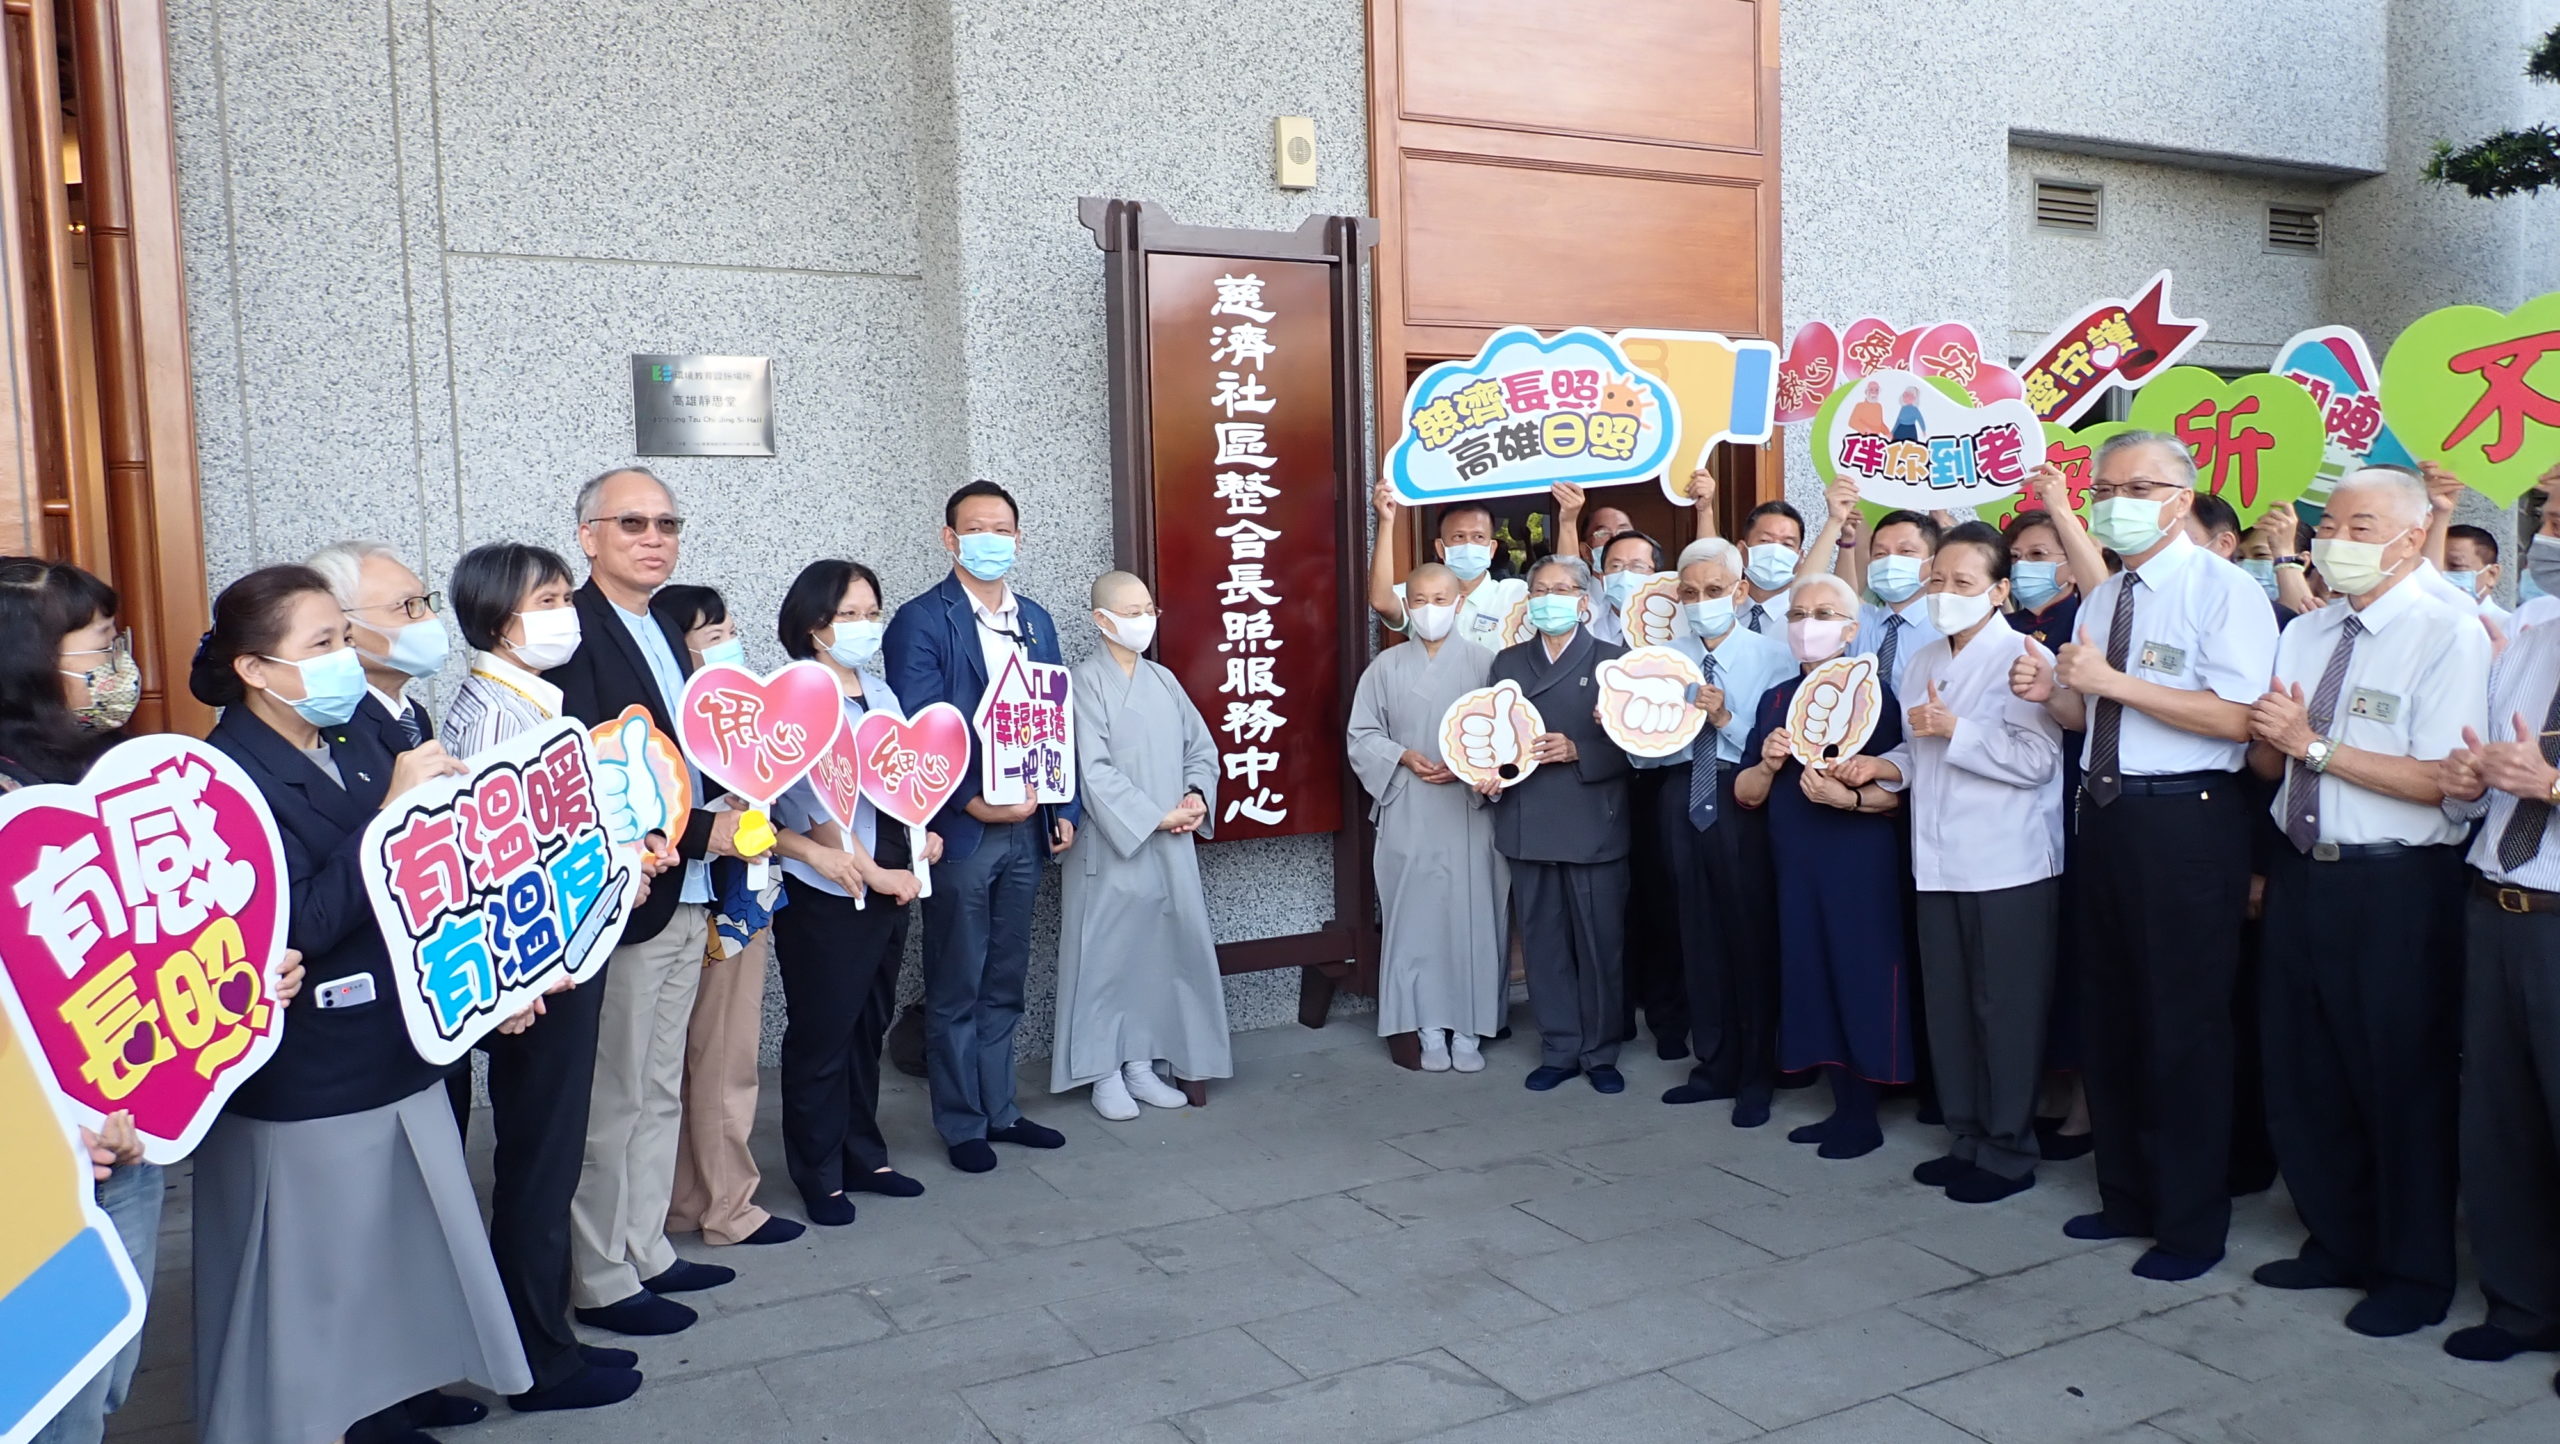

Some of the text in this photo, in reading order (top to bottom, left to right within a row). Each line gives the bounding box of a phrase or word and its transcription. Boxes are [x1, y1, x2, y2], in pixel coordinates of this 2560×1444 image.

[1410, 369, 1600, 451] 慈濟長照
[1449, 412, 1640, 482] 高雄日照
[2441, 330, 2560, 463] 不
[1841, 424, 2025, 489] 伴你到老
[1210, 273, 1287, 826] 慈濟社區整合長照服務中心
[696, 690, 806, 781] 用心
[869, 726, 949, 808] 細心
[995, 701, 1066, 749] 幸福生活
[12, 759, 256, 979] 有感
[388, 738, 594, 930] 有溫暖
[420, 833, 608, 1030] 有溫度
[58, 917, 270, 1100] 長照
